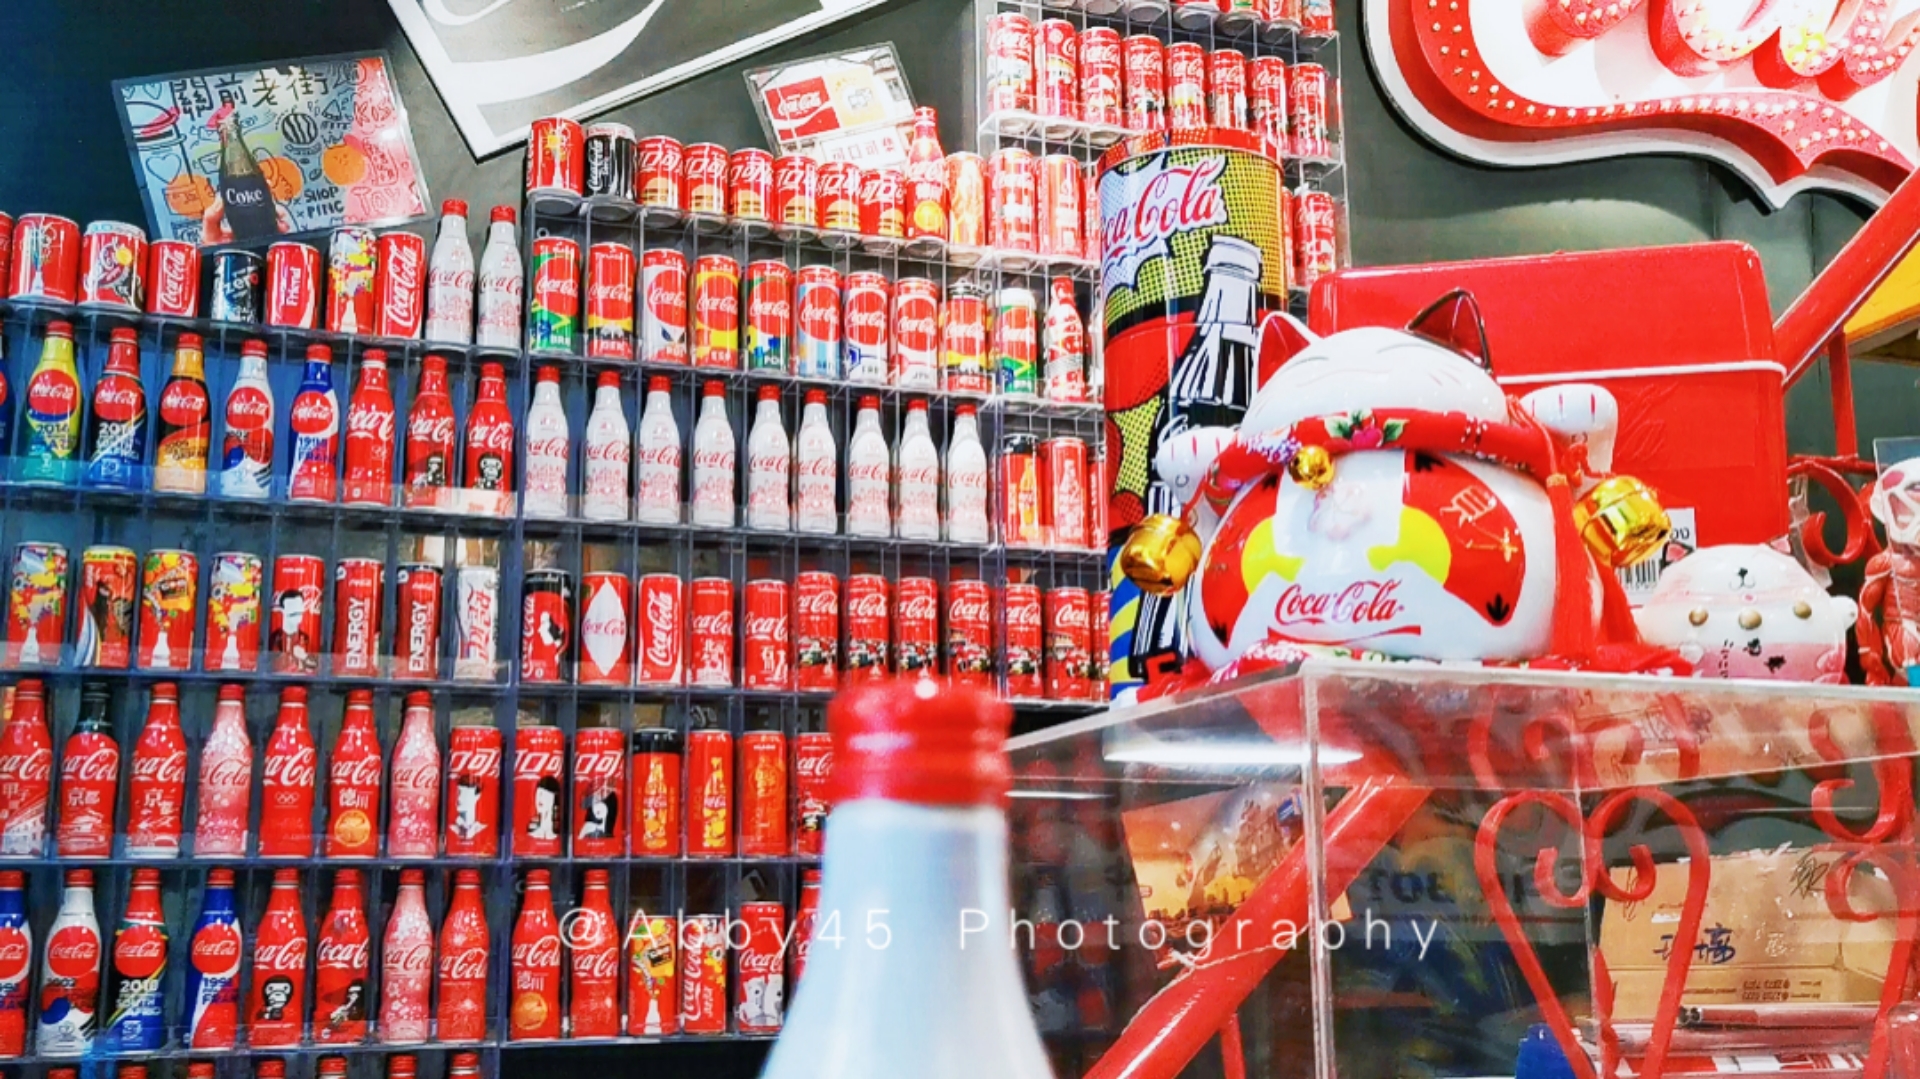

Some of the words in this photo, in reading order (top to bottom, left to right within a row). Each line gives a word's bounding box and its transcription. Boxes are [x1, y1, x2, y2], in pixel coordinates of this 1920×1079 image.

[171, 64, 330, 118] 關前老街
[226, 188, 263, 206] Coke
[304, 186, 340, 202] SHOP
[384, 240, 418, 327] Coca-Cola
[347, 597, 365, 669] ENERGY
[647, 587, 673, 667] Coca-Cola
[1275, 579, 1404, 626] Coca-Cola
[409, 600, 428, 672] ENERGY
